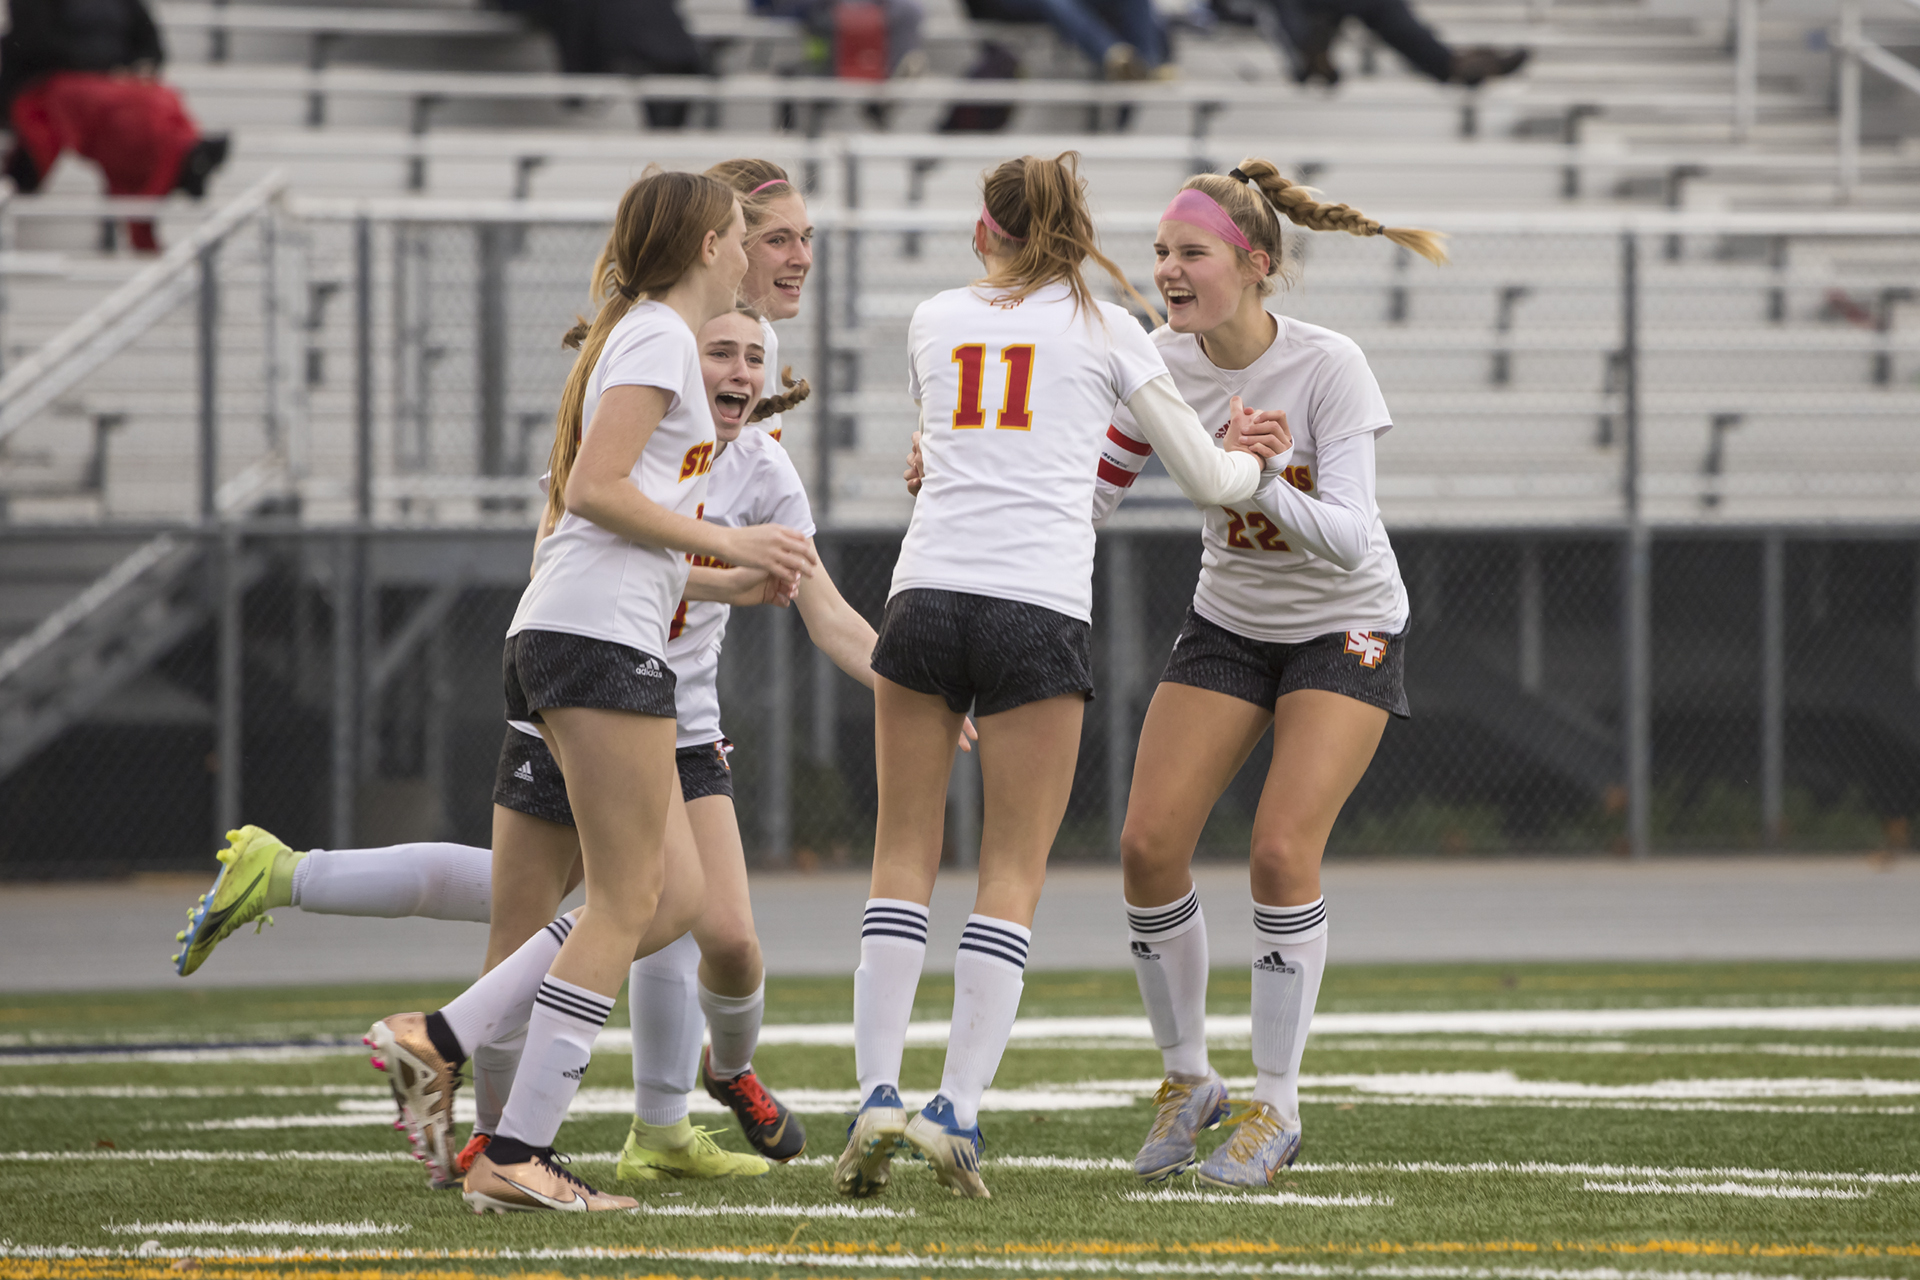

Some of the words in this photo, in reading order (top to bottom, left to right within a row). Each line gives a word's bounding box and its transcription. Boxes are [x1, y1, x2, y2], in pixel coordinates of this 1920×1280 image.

[951, 343, 1036, 431] 11
[1220, 505, 1292, 552] 22
[635, 667, 663, 679] adidas
[1253, 962, 1296, 975] adidas
